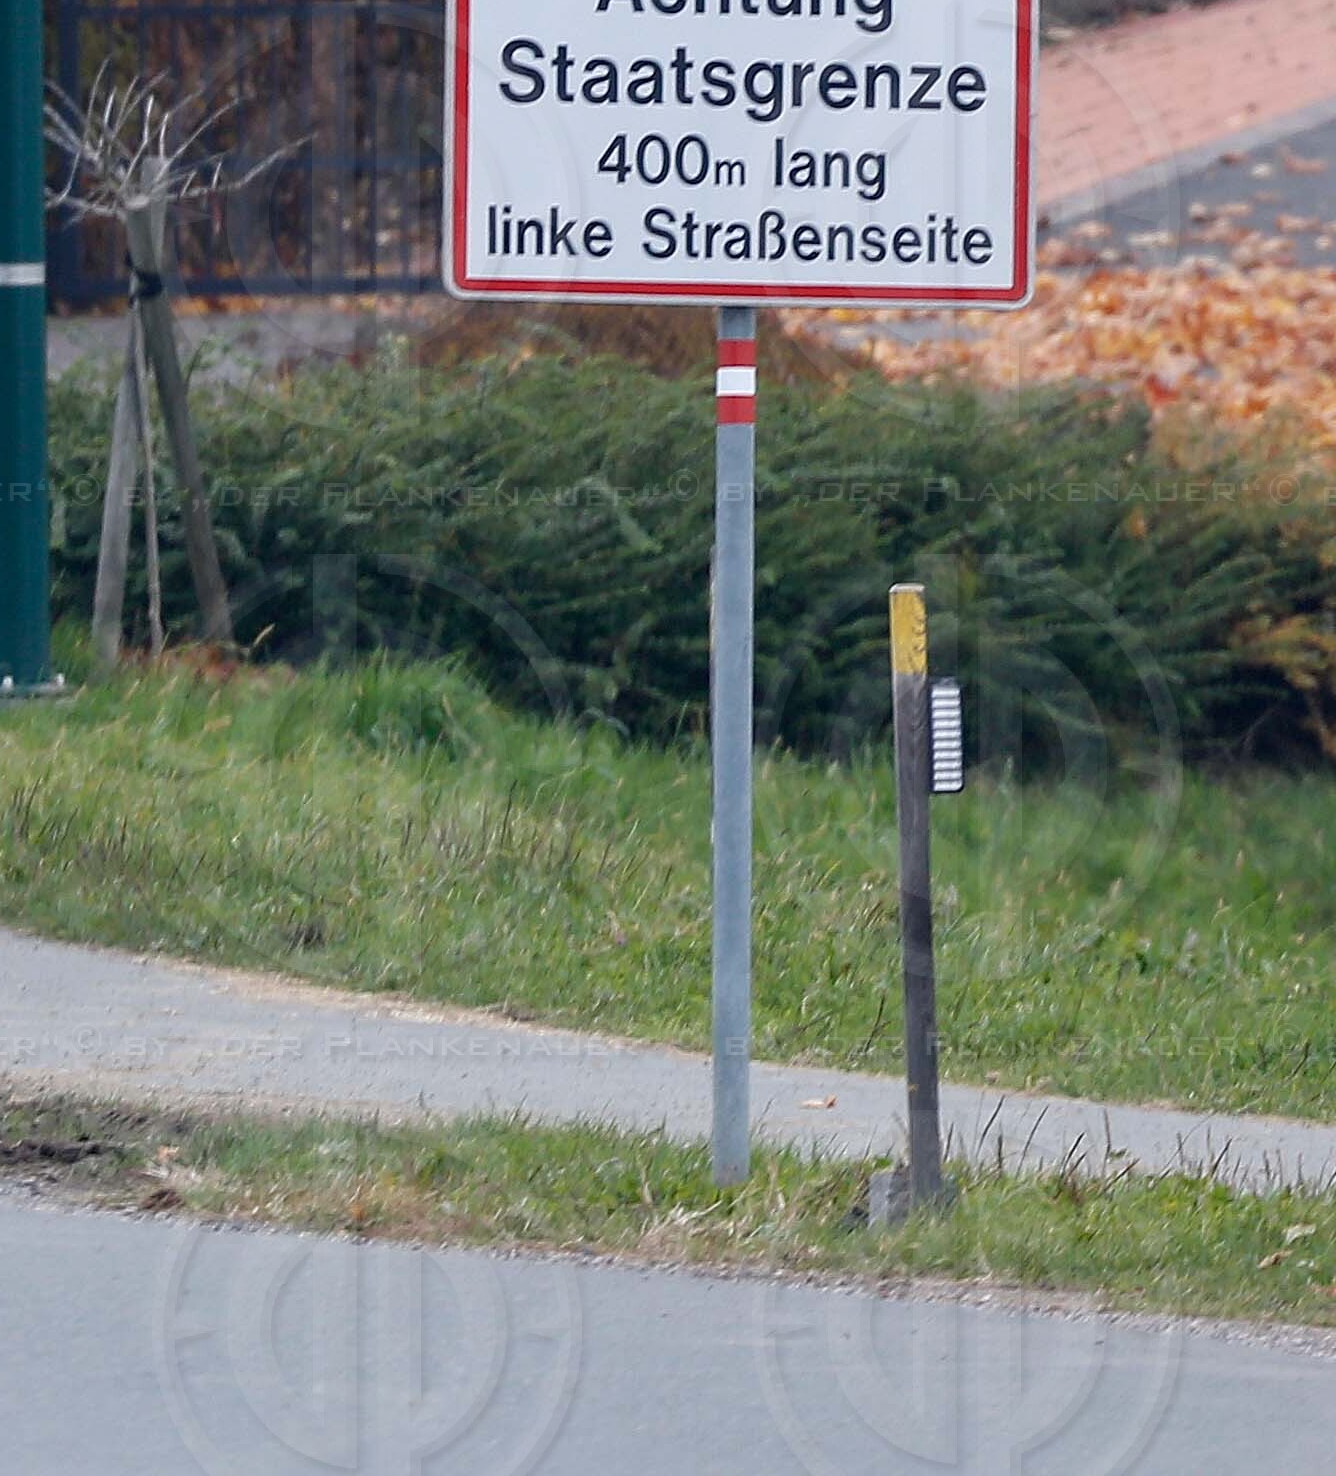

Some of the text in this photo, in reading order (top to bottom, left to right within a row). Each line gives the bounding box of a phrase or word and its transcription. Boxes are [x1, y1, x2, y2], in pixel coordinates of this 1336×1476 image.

[499, 39, 987, 122] Staatsgrenze
[598, 133, 886, 200] 400m lang
[488, 205, 993, 264] linke Straßenseite
